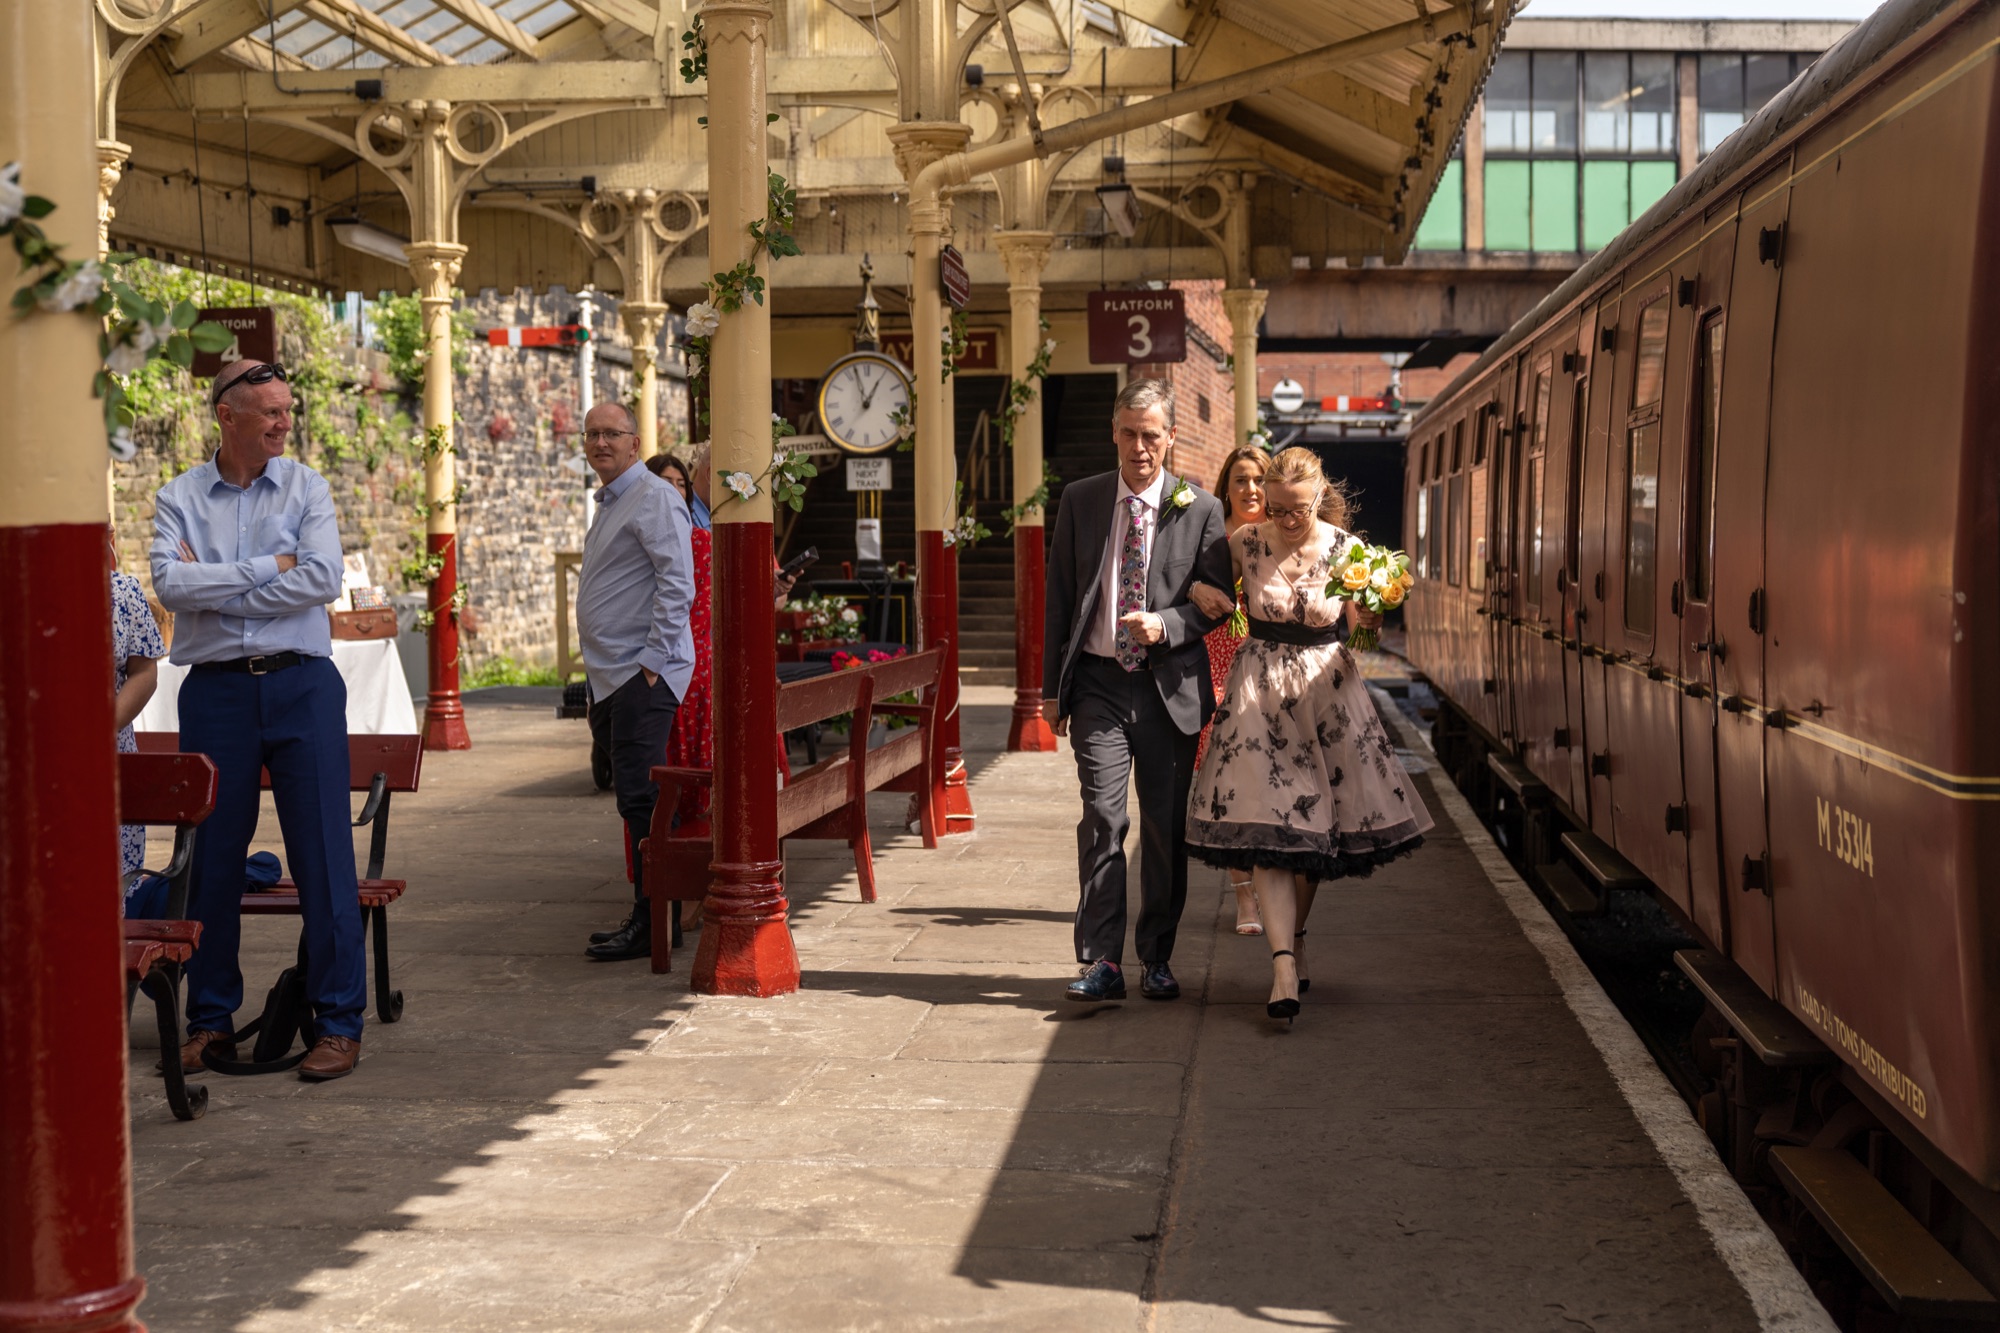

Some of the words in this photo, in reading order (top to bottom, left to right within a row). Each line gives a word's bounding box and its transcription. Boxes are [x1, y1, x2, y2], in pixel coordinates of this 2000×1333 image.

[1103, 299, 1174, 312] PLATFORM
[202, 319, 257, 330] TFORM
[1127, 314, 1153, 359] 3
[220, 334, 243, 363] 4
[880, 342, 912, 361] AY
[952, 341, 988, 360] UT
[852, 461, 870, 469] TIME
[871, 461, 882, 469] OF
[855, 471, 879, 479] NEXT
[856, 480, 880, 488] TRAIN
[1816, 795, 1831, 852] M
[1835, 805, 1874, 878] 35314
[1799, 985, 1820, 1024] LOAD
[1834, 1014, 1859, 1059] TONS
[1860, 1036, 1927, 1120] DISTRIBUTED
